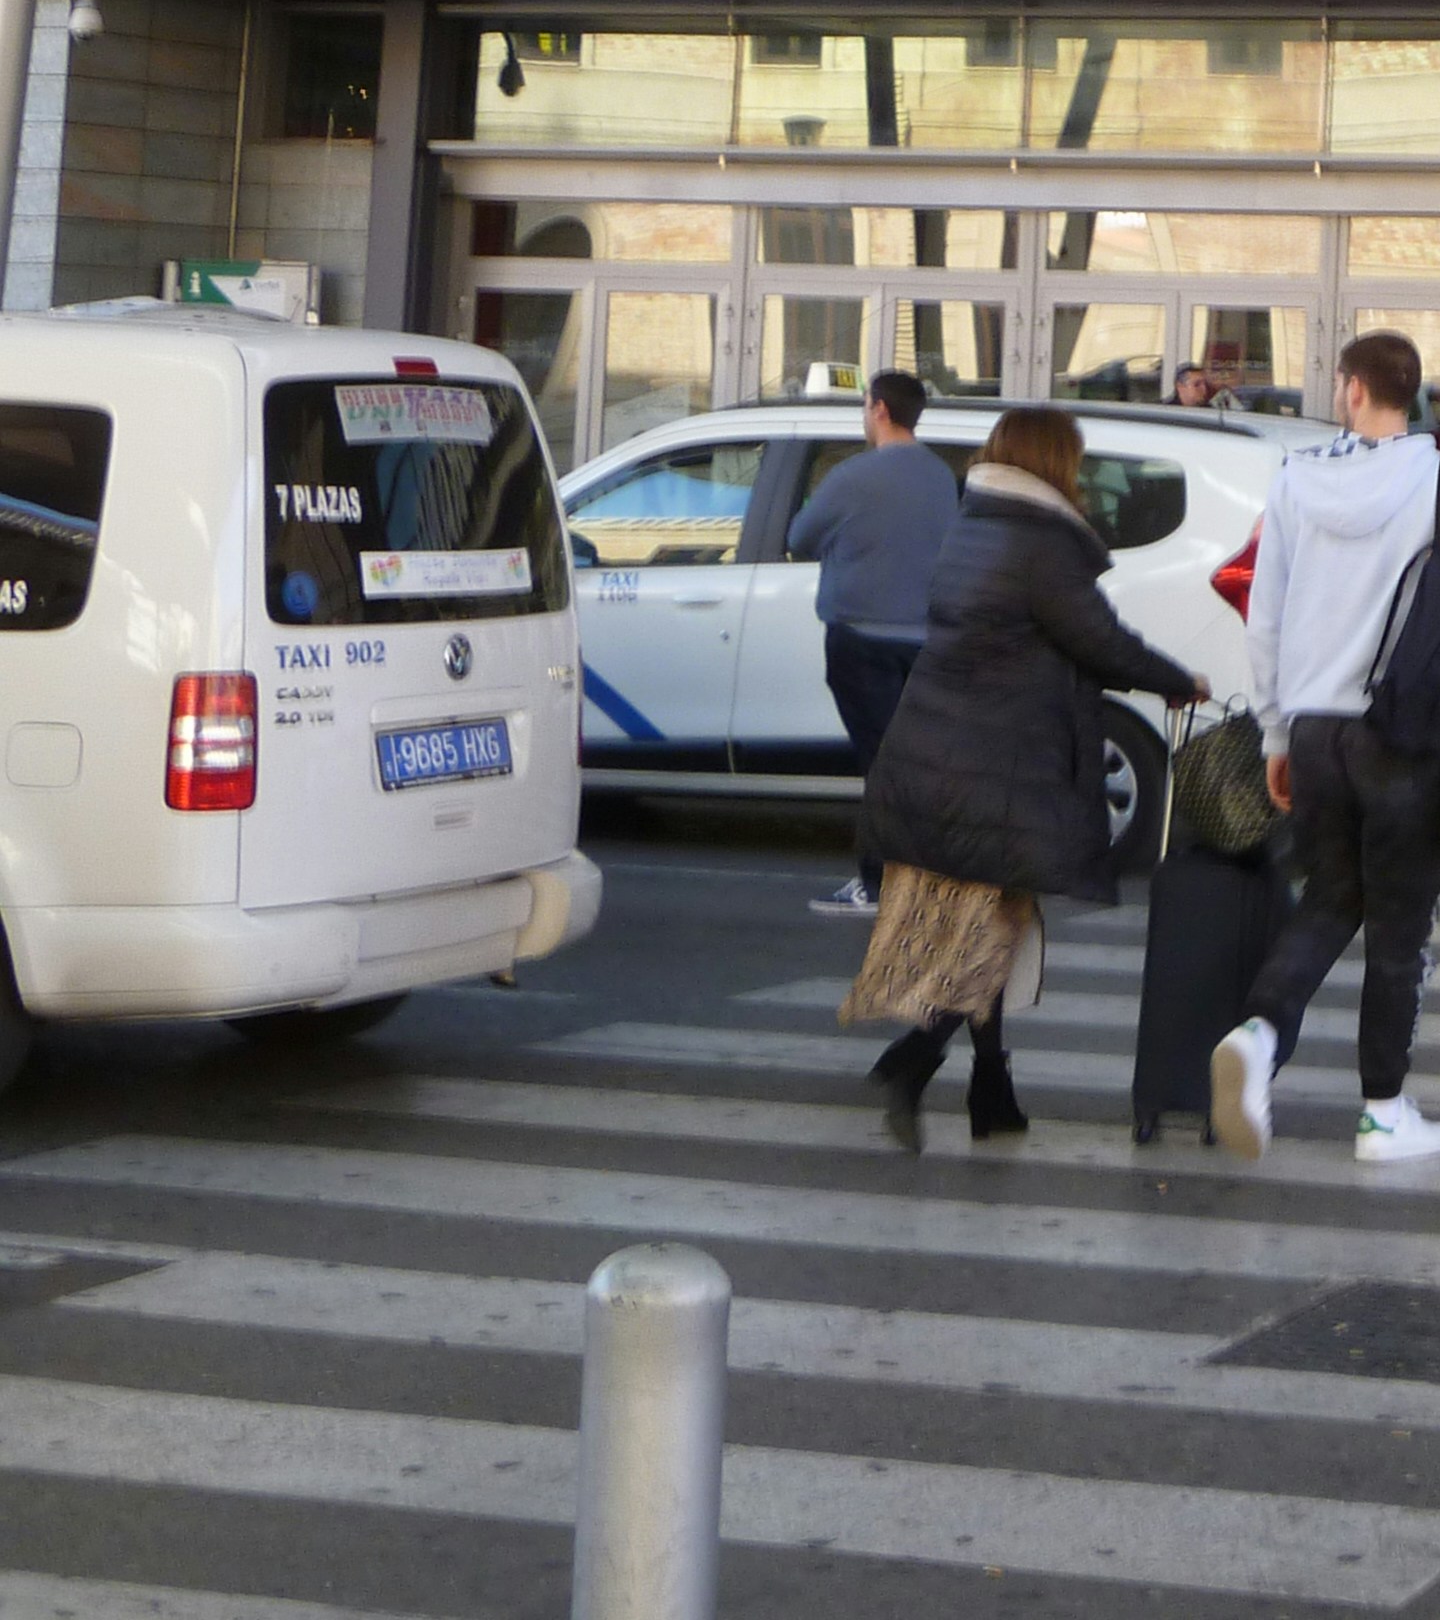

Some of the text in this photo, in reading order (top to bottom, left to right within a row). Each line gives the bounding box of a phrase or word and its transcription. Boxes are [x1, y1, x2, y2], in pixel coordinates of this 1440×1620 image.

[275, 484, 363, 524] 7 PLAZAS
[600, 571, 639, 587] TAXI
[274, 640, 386, 670] TAXI 902
[400, 726, 501, 772] 9685 HXG
